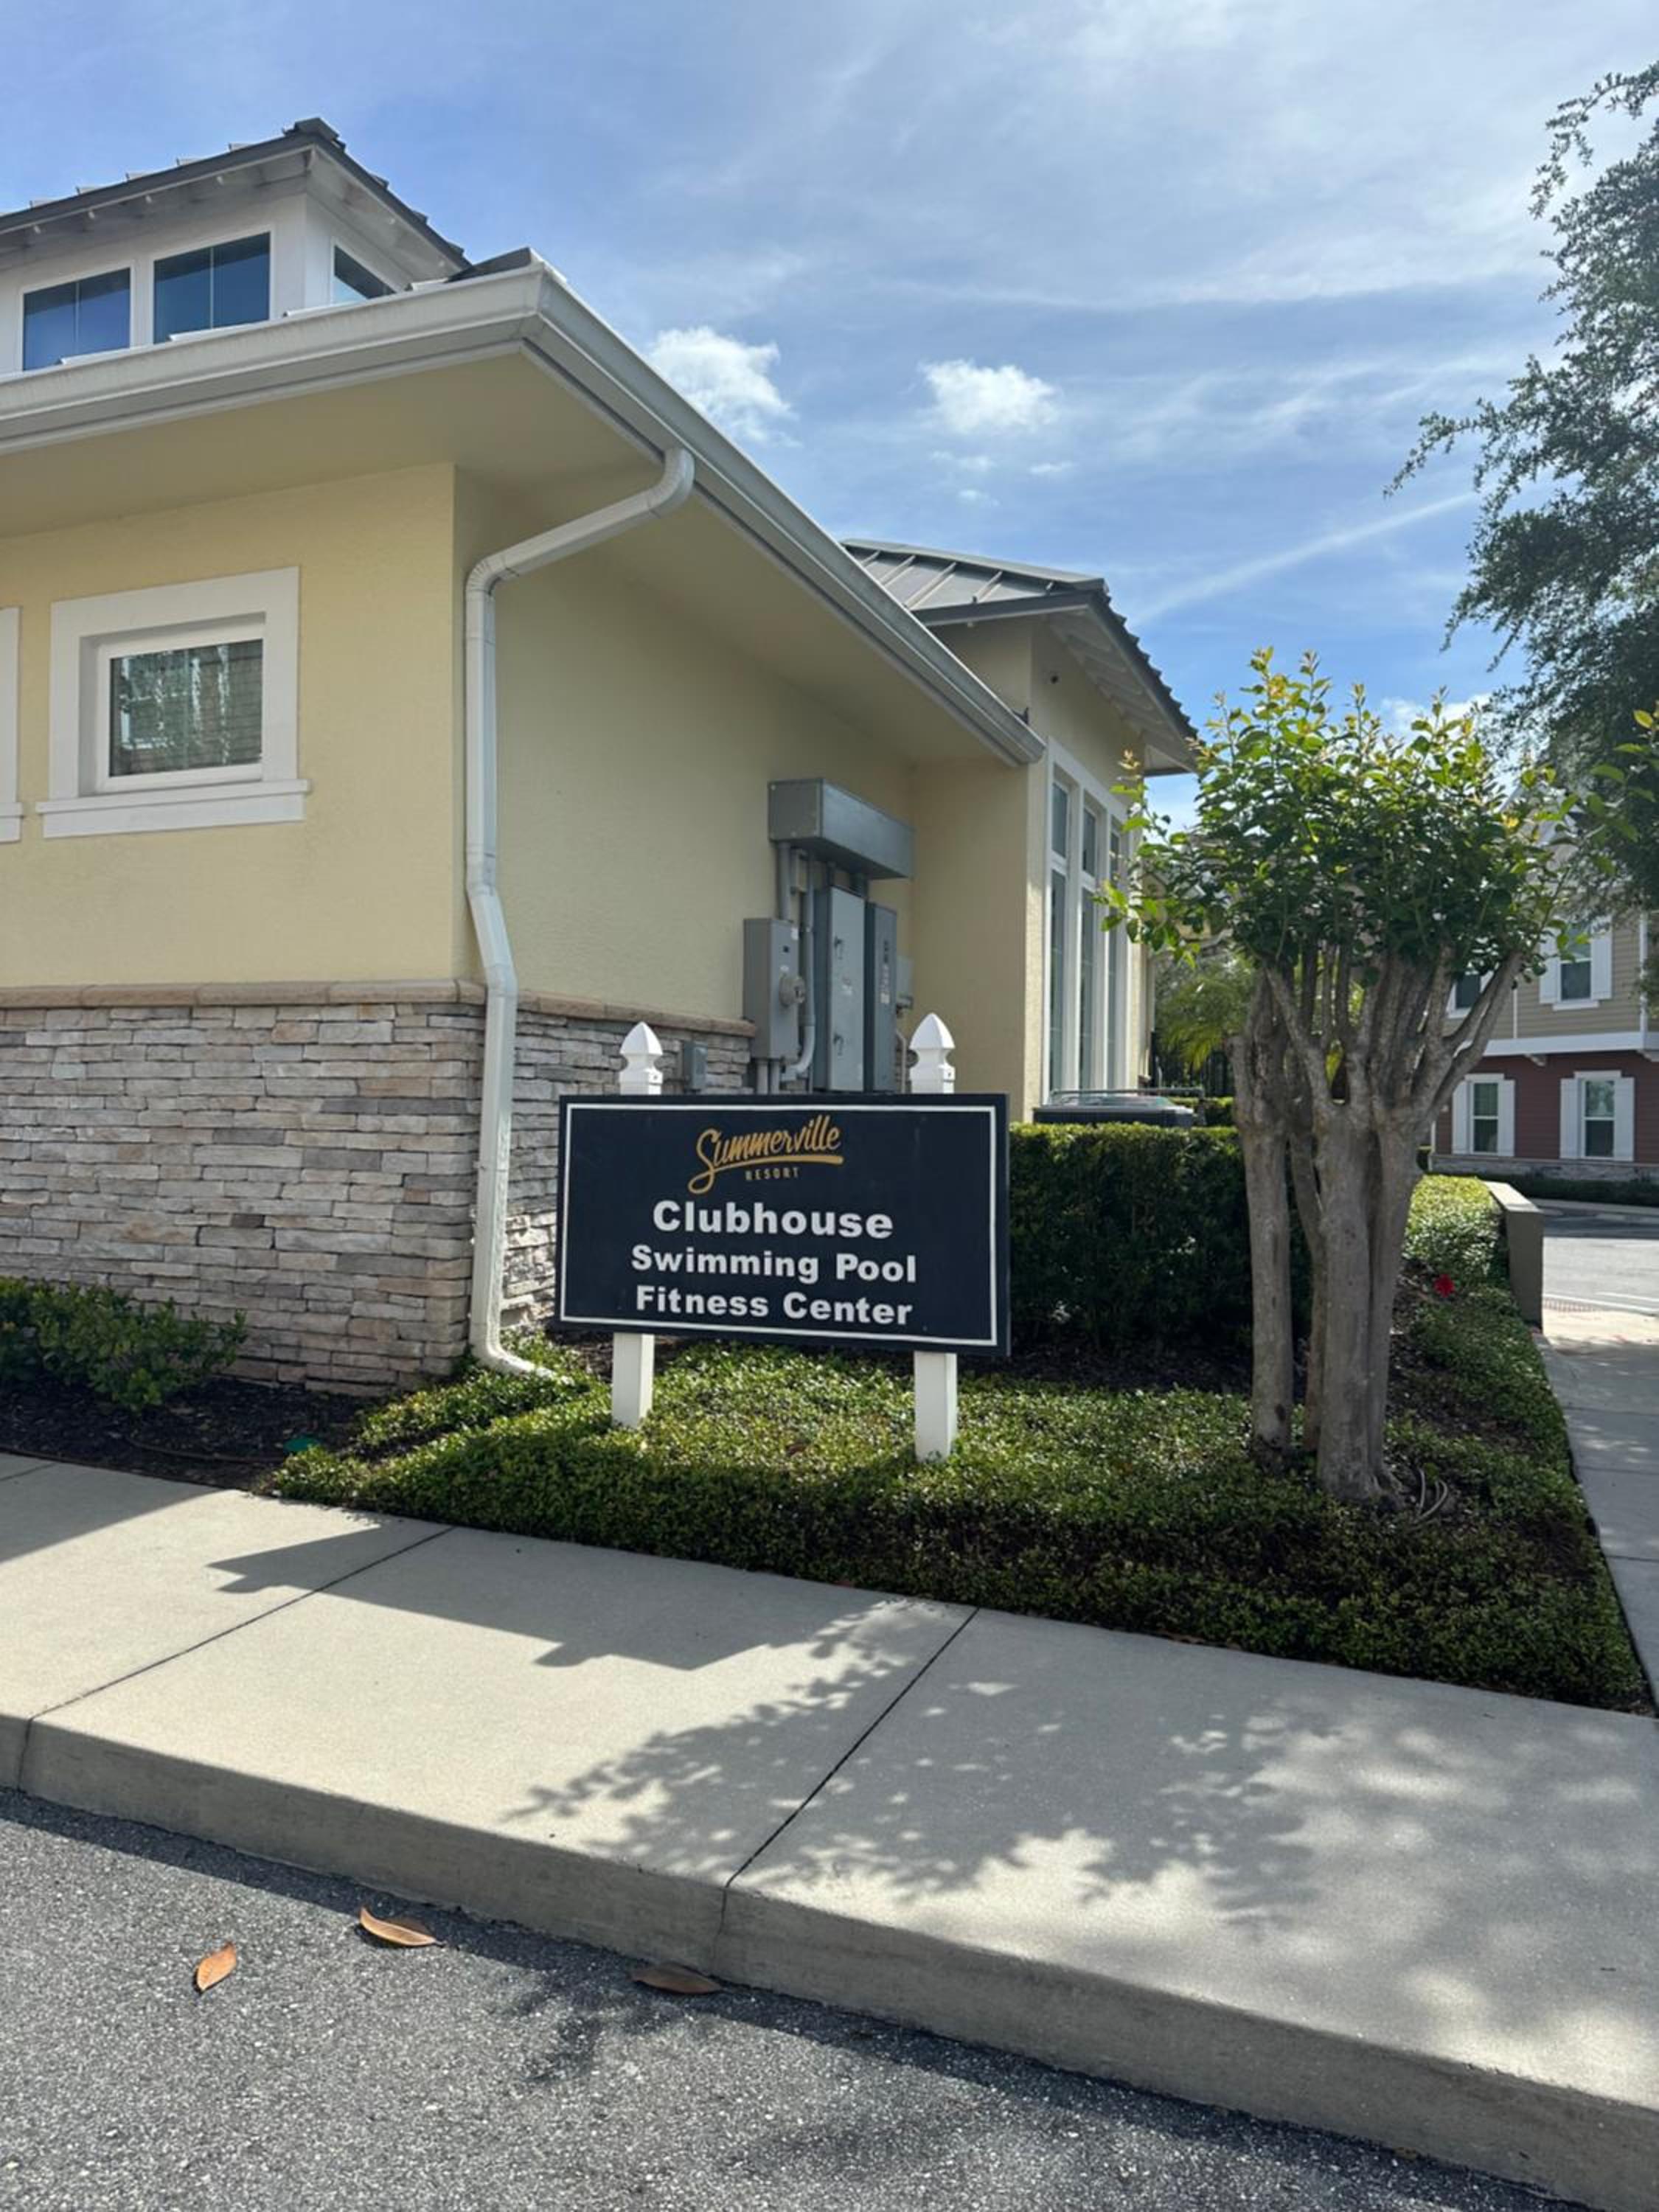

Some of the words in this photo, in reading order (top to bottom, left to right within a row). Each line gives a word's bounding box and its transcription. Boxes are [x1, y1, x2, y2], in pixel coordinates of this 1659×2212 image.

[688, 1114, 844, 1194] Summerville
[745, 1166, 799, 1181] RESORT
[653, 1200, 894, 1239] Clubhouse
[631, 1244, 818, 1284] Swimming
[836, 1253, 917, 1283] Pool
[636, 1284, 769, 1317] Fitness
[783, 1291, 913, 1325] Center
